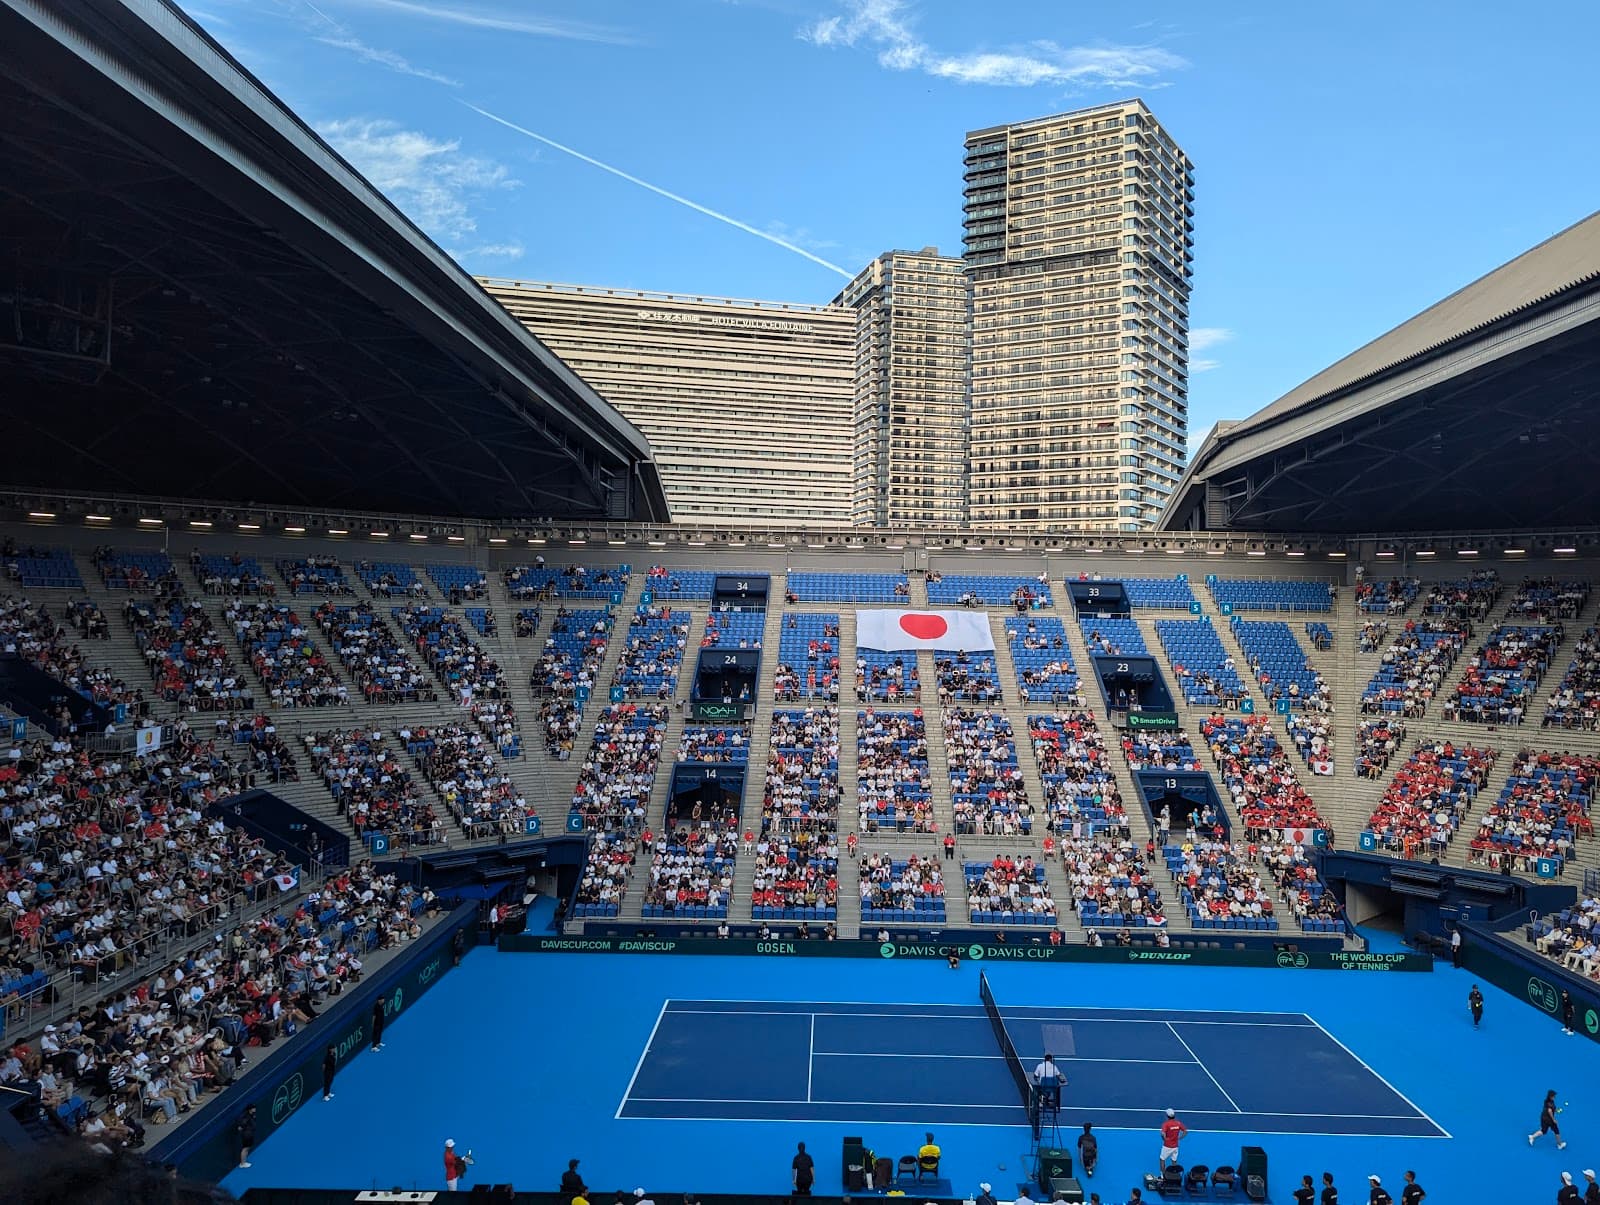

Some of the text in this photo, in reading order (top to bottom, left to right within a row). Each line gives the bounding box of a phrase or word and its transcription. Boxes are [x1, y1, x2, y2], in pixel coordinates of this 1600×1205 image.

[737, 582, 748, 591] 34
[1088, 588, 1099, 596] 33
[613, 594, 619, 602] T
[724, 656, 737, 665] 24
[1117, 663, 1129, 672] 23
[580, 690, 585, 698] L
[700, 706, 736, 715] NOAH
[1244, 702, 1251, 710] K
[1280, 703, 1285, 711] J
[1139, 718, 1176, 726] SmartDrive
[15, 723, 25, 734] M
[704, 769, 717, 779] 14
[1165, 779, 1177, 789] 13
[529, 820, 537, 830] D
[572, 818, 579, 828] C
[1317, 833, 1325, 842] C
[1364, 837, 1371, 847] B
[376, 839, 385, 850] D
[1542, 862, 1550, 873] B
[541, 939, 676, 951] DAVISCUP.COM #DAVISCUP
[756, 942, 794, 954] GOSEN
[899, 945, 966, 956] DAVIS CP
[987, 947, 1054, 958] DAVIS CUP
[1138, 952, 1192, 961] DUNLOP
[1330, 952, 1406, 964] THE WORLD CUP
[1341, 961, 1390, 971] OF TENNIS
[338, 1025, 364, 1059] DAVIS
